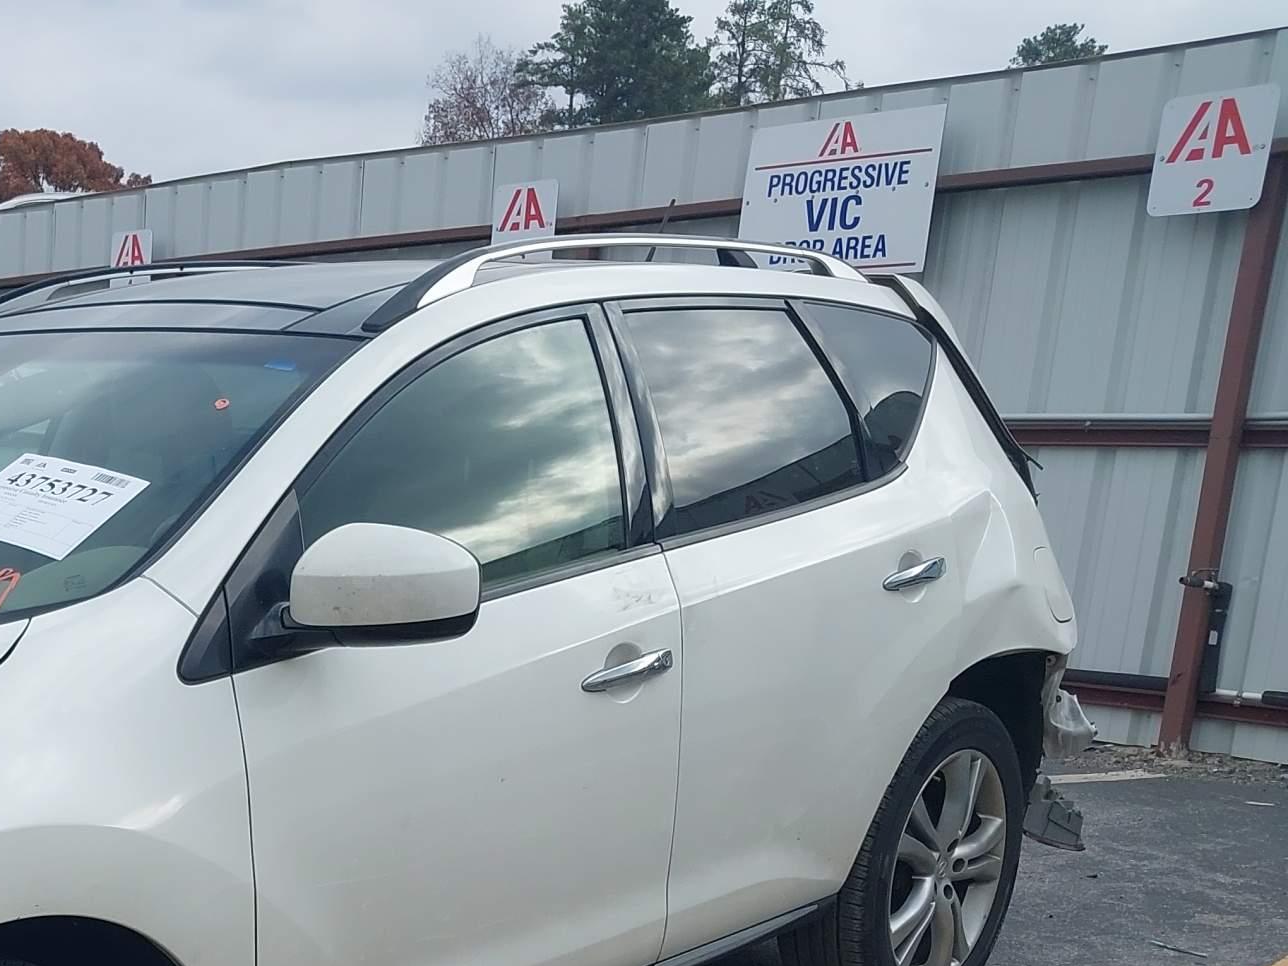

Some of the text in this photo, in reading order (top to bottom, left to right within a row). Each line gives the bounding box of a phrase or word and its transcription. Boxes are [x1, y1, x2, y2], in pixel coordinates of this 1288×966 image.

[767, 160, 911, 198] PROGRESSIVE
[1192, 178, 1214, 207] 2
[806, 194, 863, 232] VIC
[832, 234, 887, 261] AREA
[7, 471, 114, 506] 43753727
